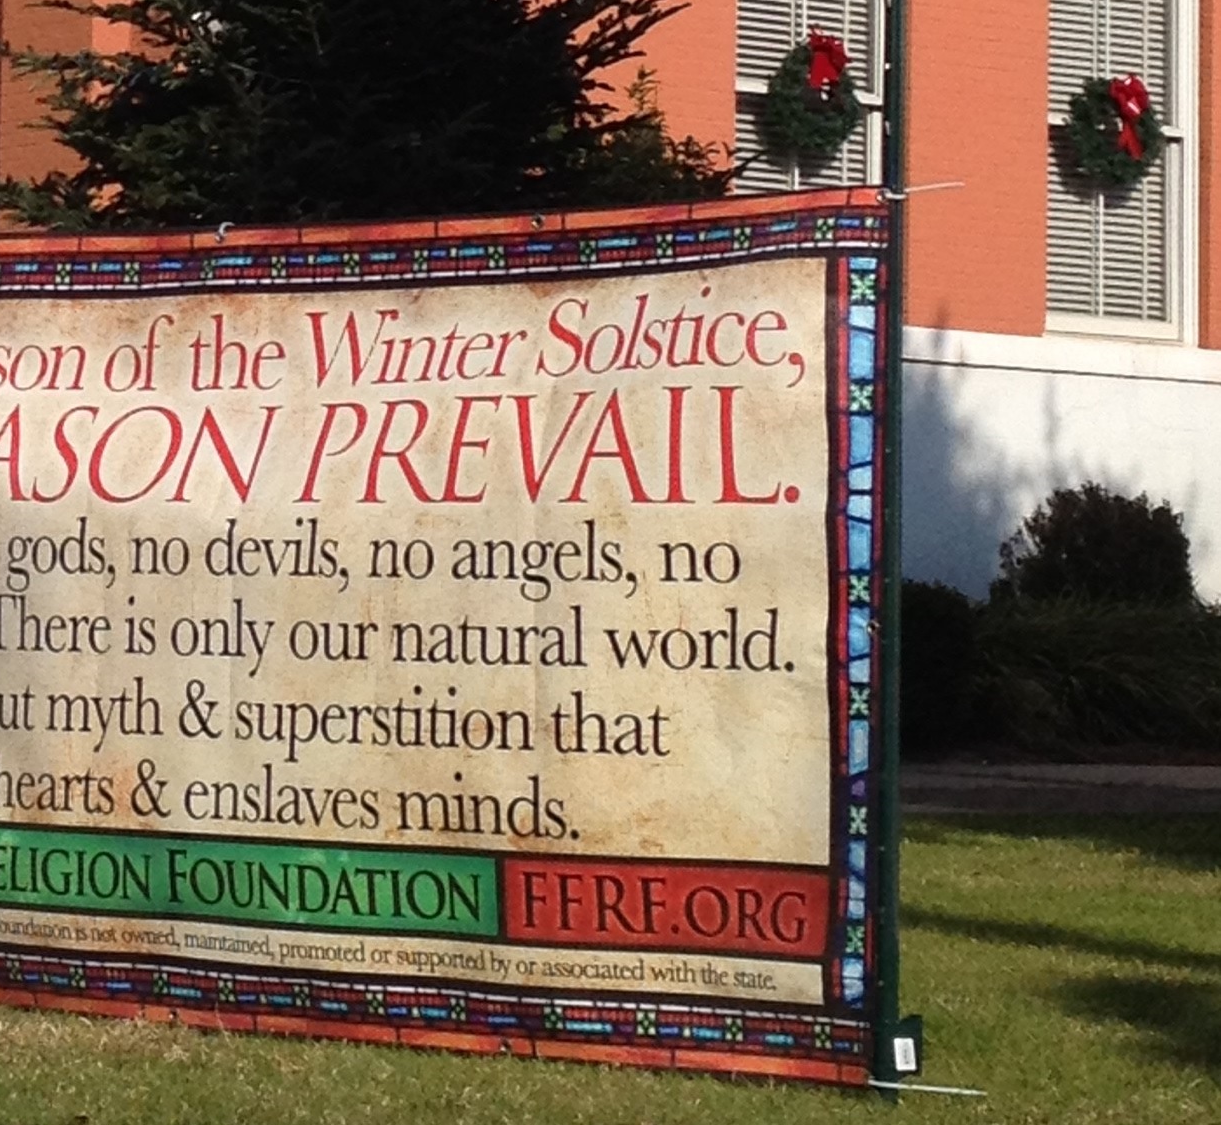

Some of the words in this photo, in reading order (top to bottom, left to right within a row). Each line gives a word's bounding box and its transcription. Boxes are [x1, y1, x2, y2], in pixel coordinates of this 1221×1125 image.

[104, 314, 175, 392] of
[190, 313, 286, 391] the
[305, 309, 526, 387] Winter
[536, 286, 807, 386] Solstice,
[293, 386, 801, 504] PREVAIL.
[7, 517, 116, 592] gods,
[130, 535, 189, 576] no
[205, 517, 350, 592] devils,
[369, 538, 435, 580] no
[451, 520, 638, 602] angels,
[658, 540, 741, 585] no
[125, 596, 157, 656] is
[170, 598, 274, 677] only
[289, 619, 379, 662] our
[391, 605, 588, 668] natural
[604, 608, 796, 674] world.
[47, 676, 165, 752] myth
[179, 679, 222, 740] &
[234, 685, 535, 763] superstition
[550, 691, 671, 757] that
[130, 758, 172, 819] &
[183, 763, 380, 830] enslaves
[397, 772, 580, 841] minds.
[168, 849, 480, 922] FOUNDATION
[522, 871, 808, 944] FFRF.ORG
[75, 922, 87, 942] is
[90, 924, 117, 943] not
[122, 926, 180, 947] owned,
[279, 941, 366, 963] promoted
[371, 950, 393, 965] or
[396, 949, 485, 973] supported
[490, 951, 511, 975] by
[516, 960, 537, 975] or
[542, 959, 644, 981] associated
[650, 960, 696, 983] with
[700, 962, 728, 985] the
[733, 971, 777, 991] state.
